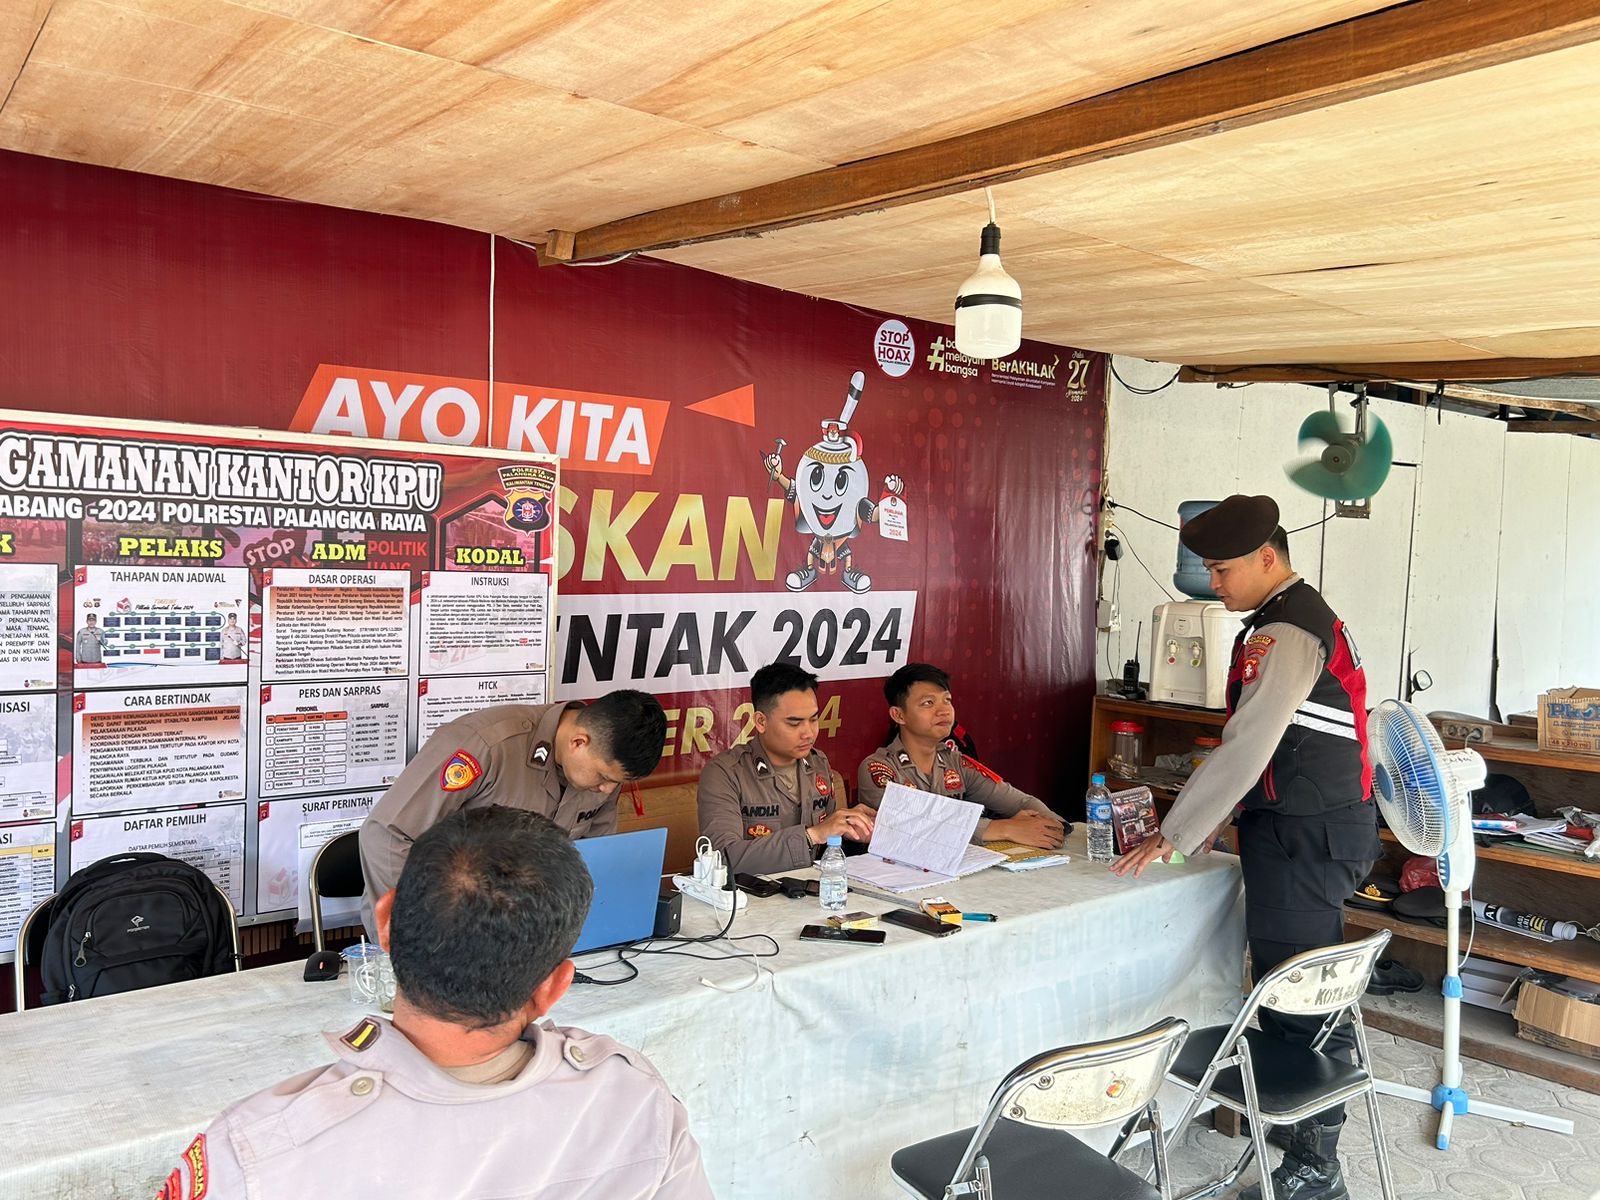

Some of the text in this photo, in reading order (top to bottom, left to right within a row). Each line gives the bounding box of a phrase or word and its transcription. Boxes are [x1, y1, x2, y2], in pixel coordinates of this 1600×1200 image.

[880, 330, 909, 345] STOP
[878, 346, 910, 362] HOAX
[945, 362, 978, 378] bangsa
[991, 358, 1056, 379] BerAKHLAK
[1067, 360, 1090, 389] 27
[310, 377, 652, 466] AYO KITA
[0, 434, 438, 508] GAMANAN KANTOR KPU
[0, 495, 83, 519] ABANG
[162, 502, 268, 526] POLRESTA
[273, 507, 376, 531] PALANGKA
[380, 512, 428, 532] RAYA
[119, 537, 223, 558] PELAKS
[312, 542, 366, 561] ADM
[456, 547, 524, 566] KODAL
[246, 537, 295, 566] STOP
[367, 540, 428, 557] POLITIK
[110, 571, 226, 584] TAHAPAN DAN JADWAL
[308, 574, 377, 585] DASAR OPERASI
[471, 576, 510, 587] INSTRUKSI
[555, 610, 758, 684] NTAK
[772, 607, 903, 669] 2024
[298, 685, 381, 699] PERS DAN SARPRAS
[478, 680, 498, 690] HTCK
[124, 693, 211, 707] CARA BERTINDAK
[301, 797, 373, 813] SURAT PERINTAH
[124, 814, 207, 831] DAFTAR PEMILIH
[128, 844, 148, 852] DAFTAR
[168, 839, 198, 848] SEMENTARA
